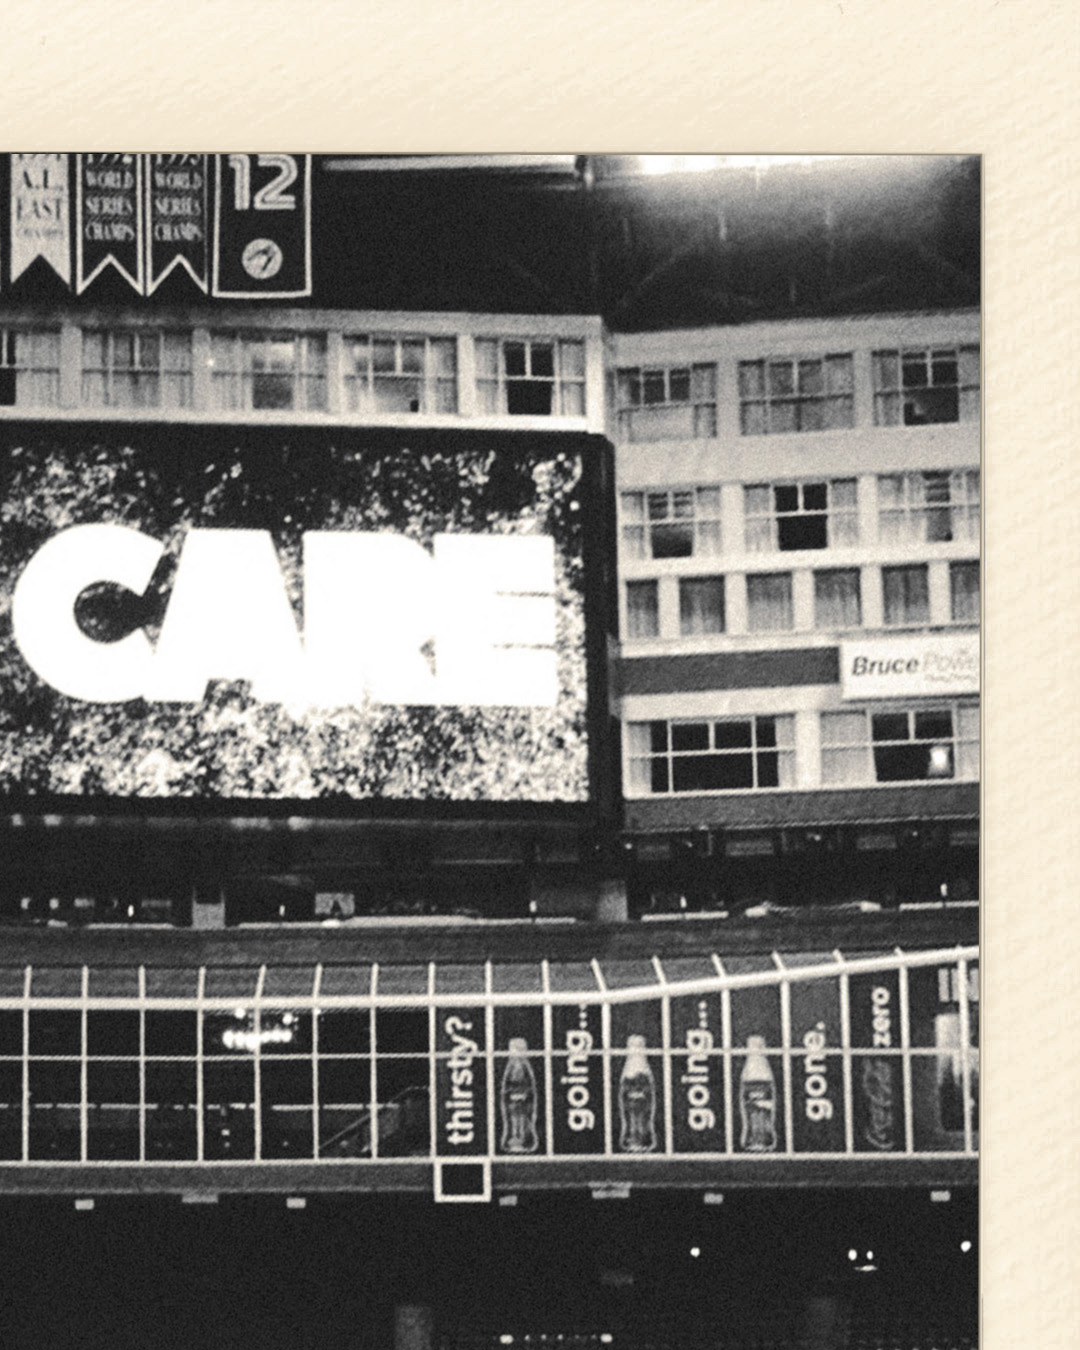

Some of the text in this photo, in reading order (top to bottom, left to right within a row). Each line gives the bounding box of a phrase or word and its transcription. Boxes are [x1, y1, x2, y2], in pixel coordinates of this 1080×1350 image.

[228, 153, 298, 210] 12
[11, 523, 556, 706] CARE
[851, 655, 920, 676] Bruce
[680, 1001, 716, 1132] going...
[871, 986, 892, 1048] zero
[445, 1015, 478, 1146] thirsty?
[803, 1020, 834, 1122] gone.
